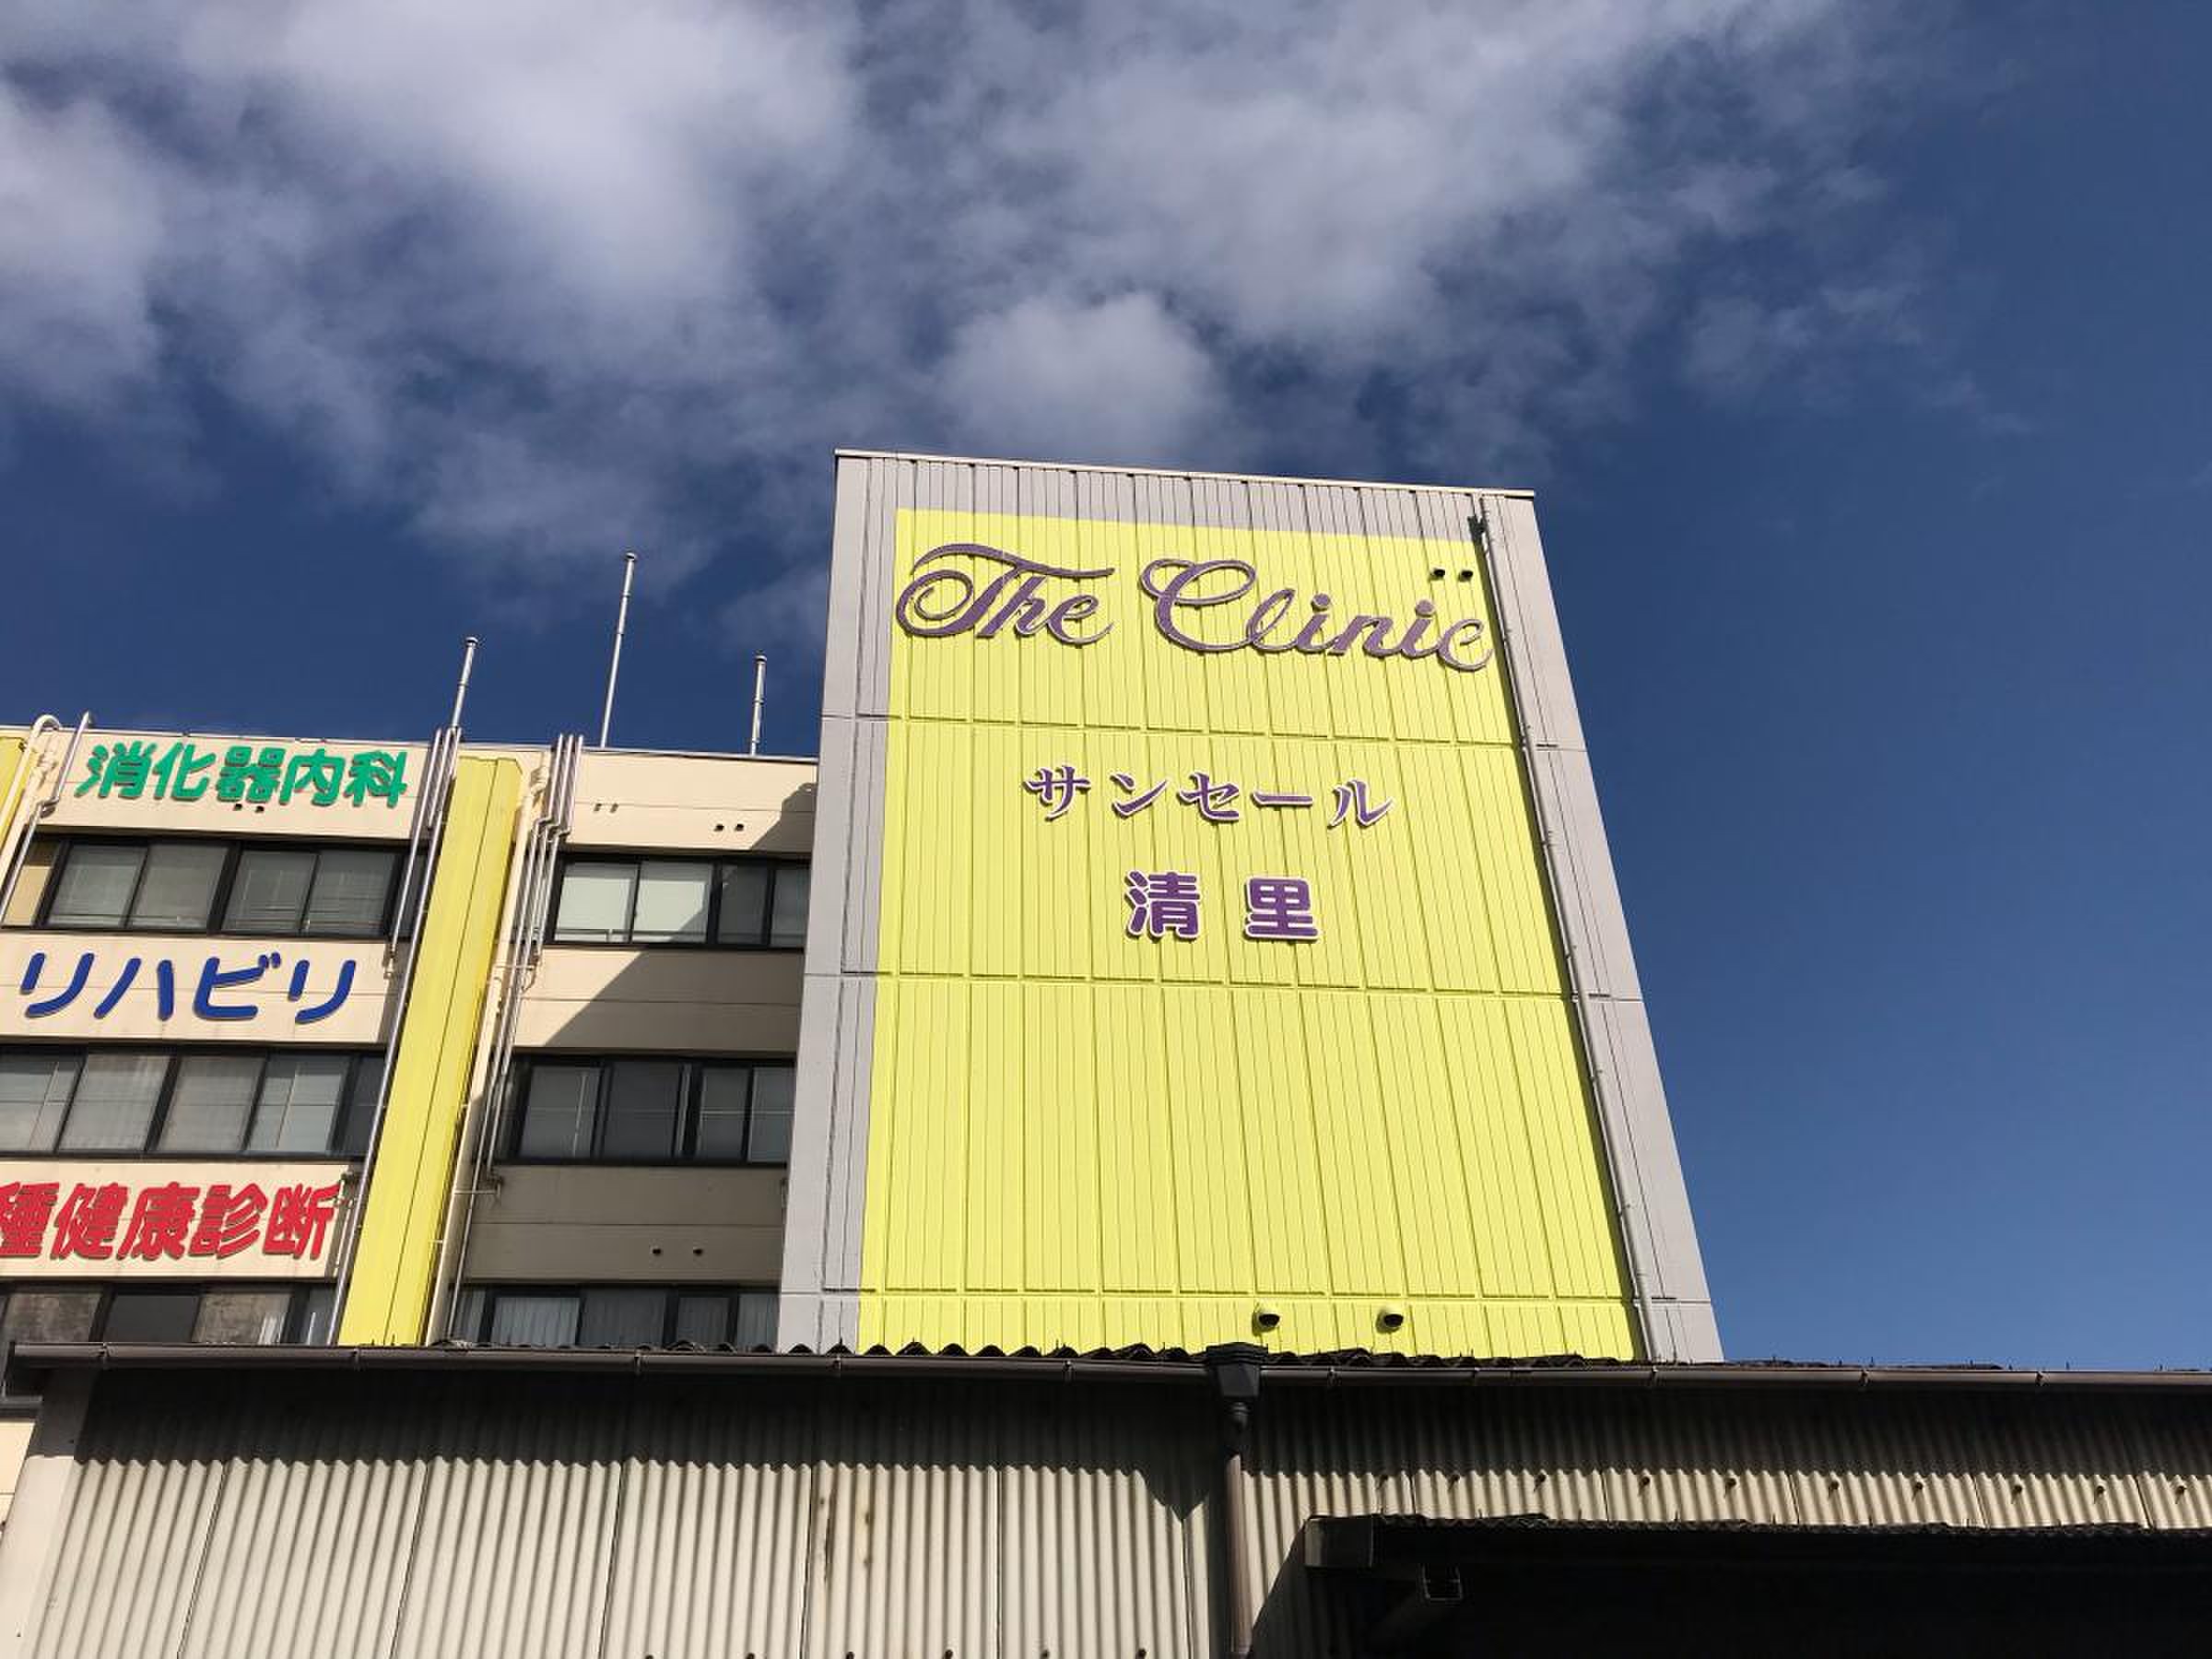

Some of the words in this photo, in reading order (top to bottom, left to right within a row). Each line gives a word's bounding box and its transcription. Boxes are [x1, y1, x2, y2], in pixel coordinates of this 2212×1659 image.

[895, 543, 1115, 646] The
[1139, 559, 1492, 671] Clinic
[75, 741, 408, 807] 消化器内科
[1022, 764, 1394, 829] サンセール
[1124, 869, 1320, 941] 清里
[20, 952, 357, 1024] リハビリ
